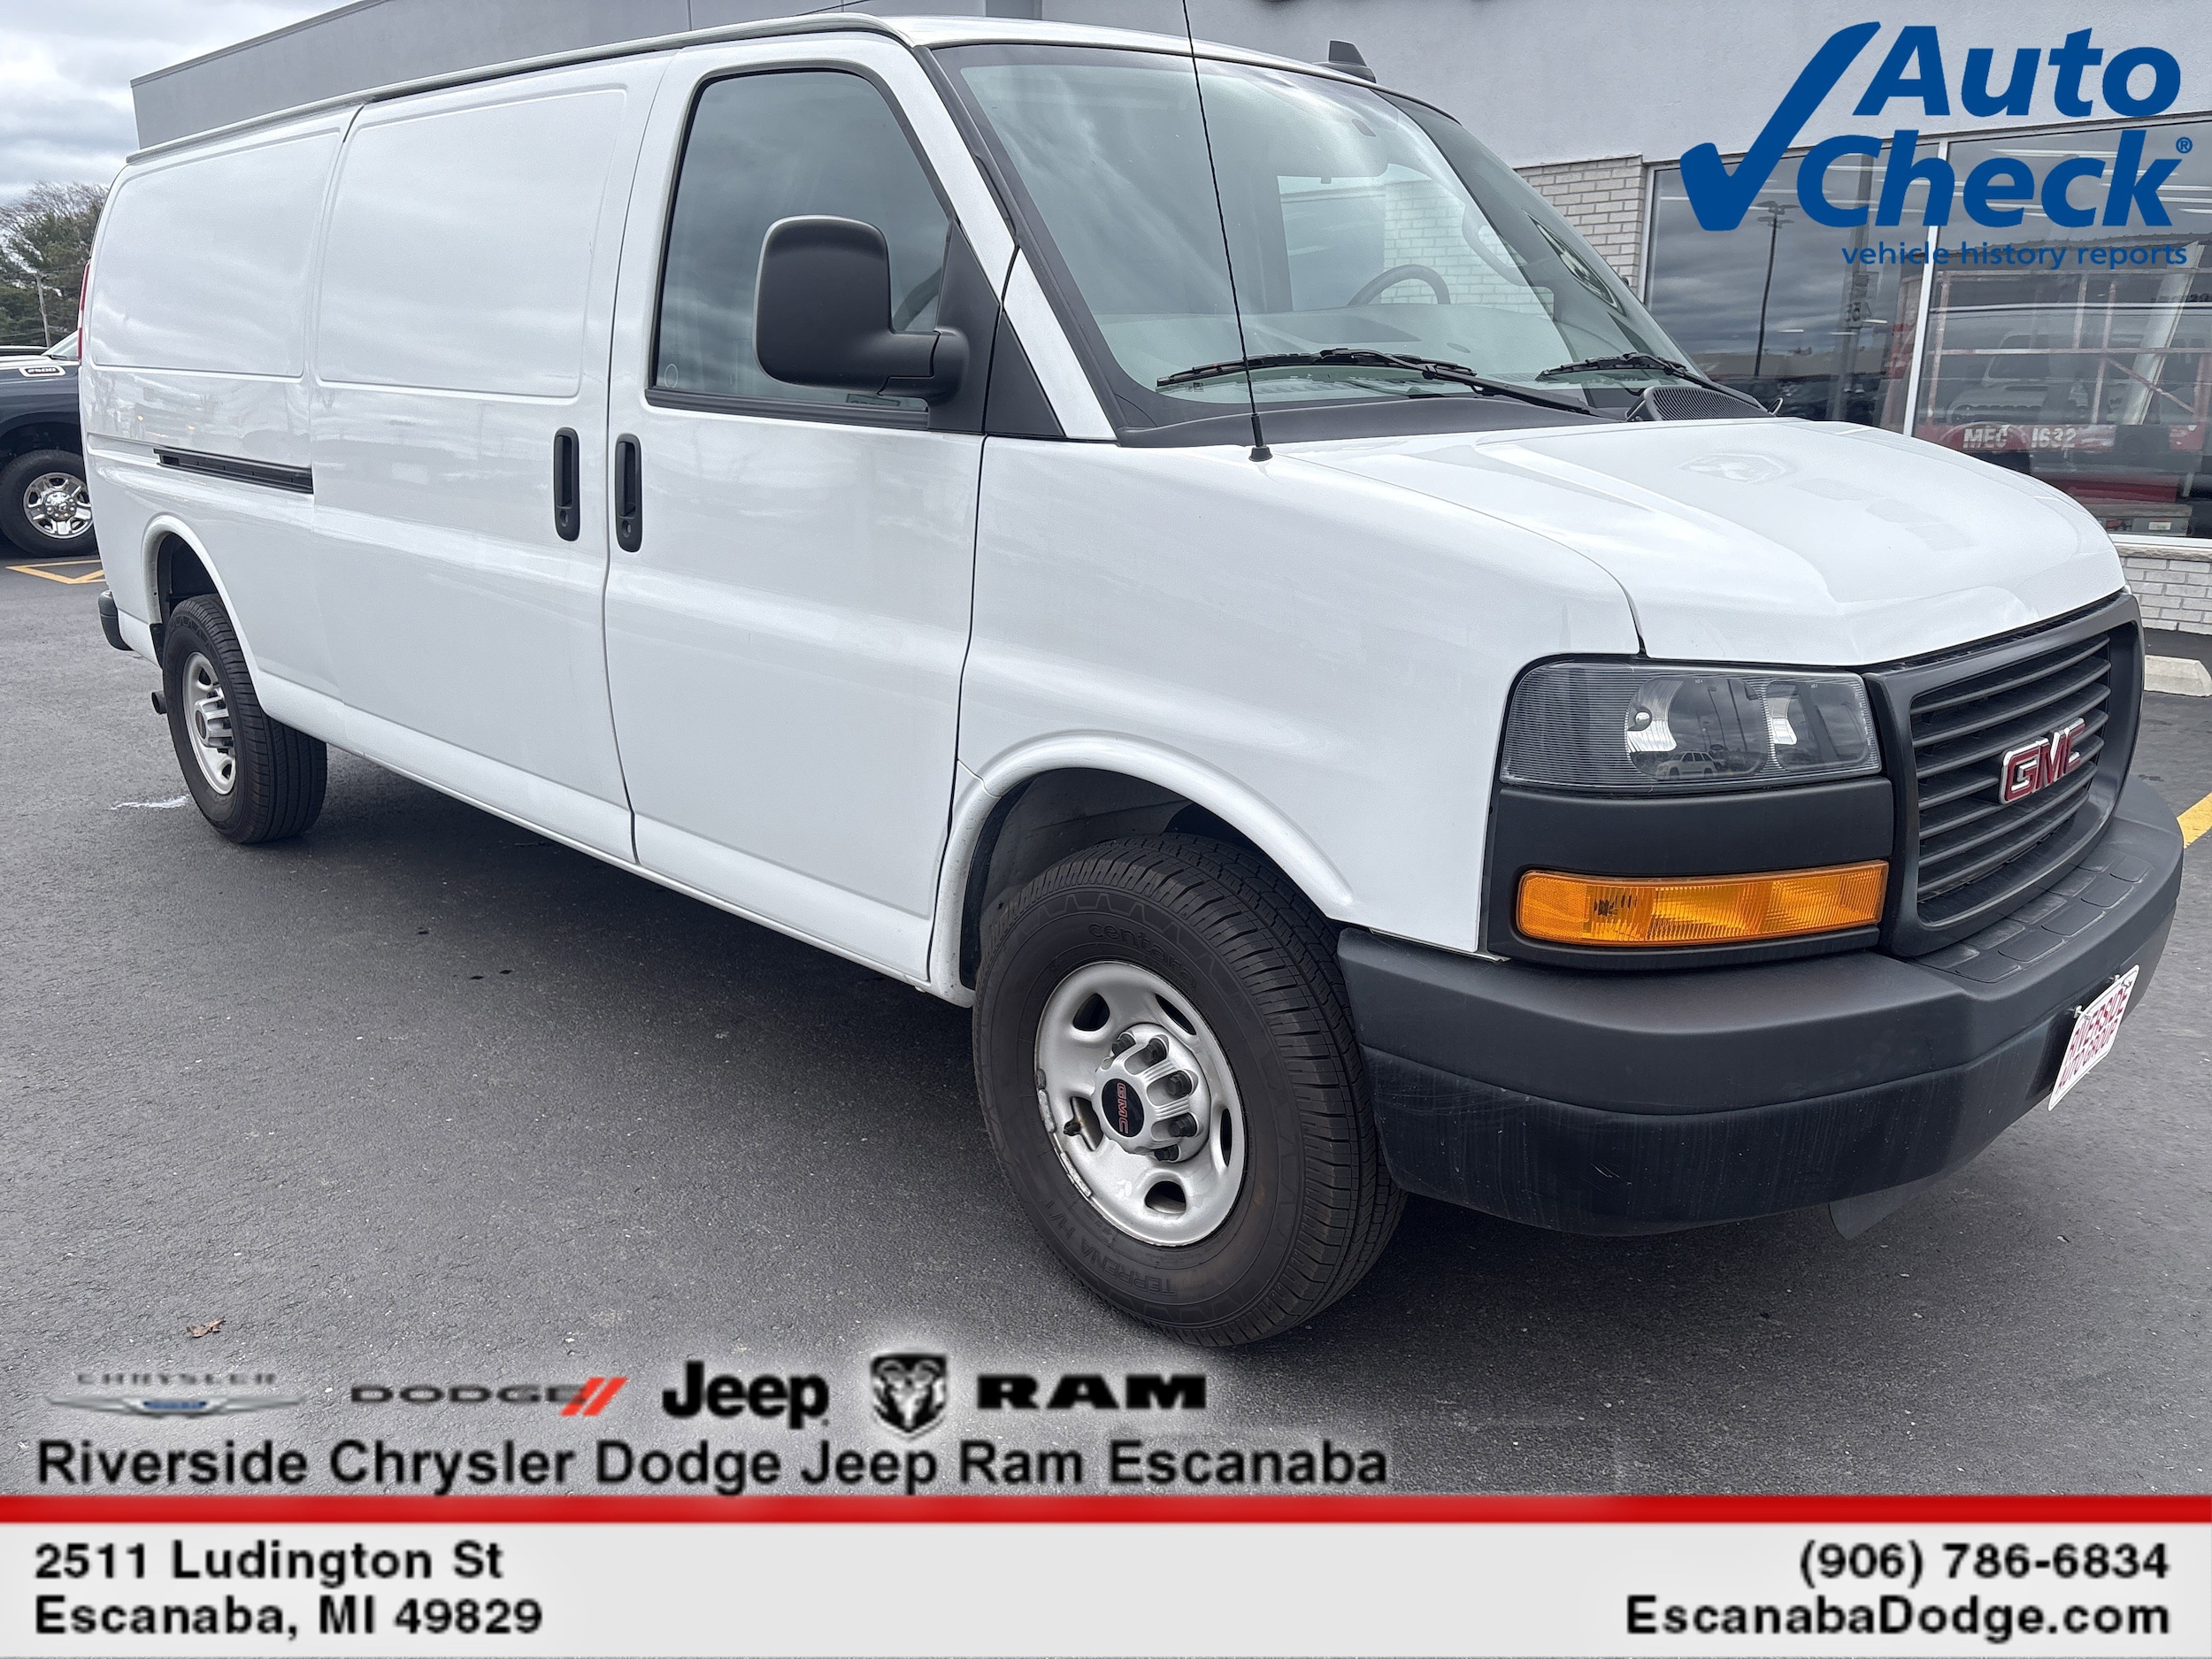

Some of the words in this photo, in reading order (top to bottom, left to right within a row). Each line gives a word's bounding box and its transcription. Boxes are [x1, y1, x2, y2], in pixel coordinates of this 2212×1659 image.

[2031, 426, 2077, 449] 1632
[2000, 718, 2085, 804] GMC
[1088, 923, 1196, 990] centara
[2057, 1048, 2085, 1090] AUTO
[2082, 1018, 2118, 1066] GROUP
[2065, 986, 2127, 1062] RIVERSIDE
[1117, 1082, 1129, 1134] GMC
